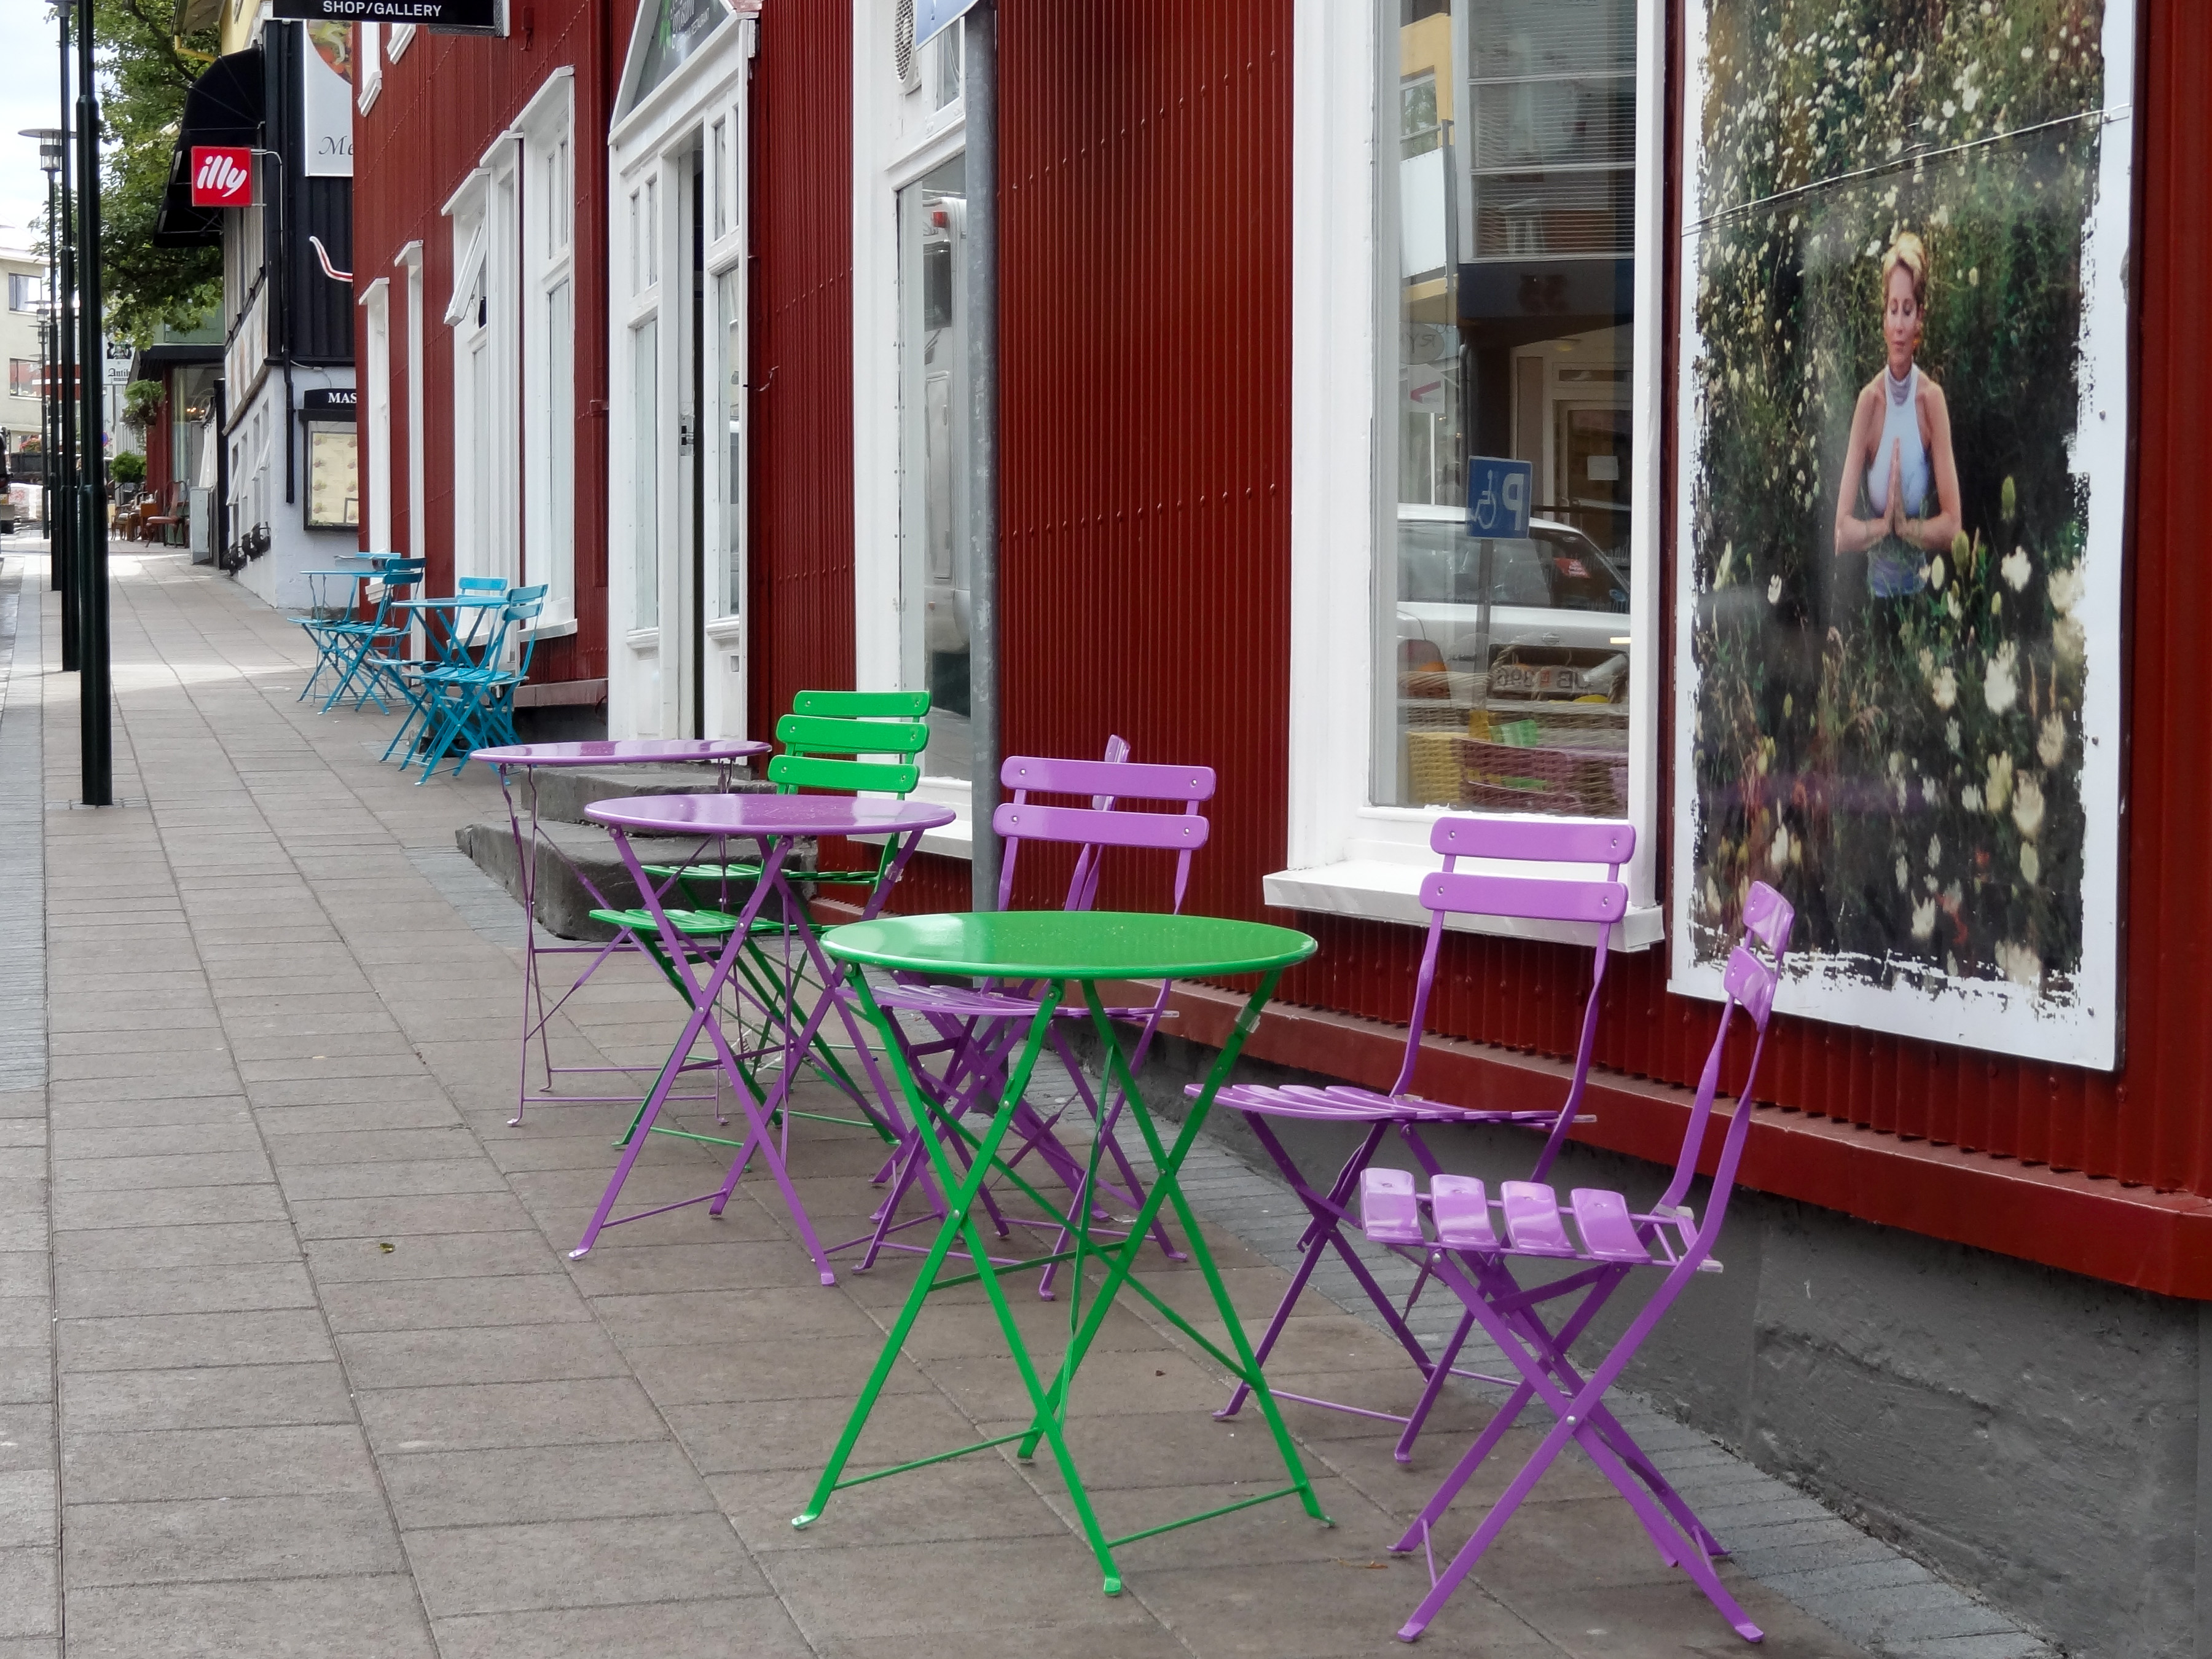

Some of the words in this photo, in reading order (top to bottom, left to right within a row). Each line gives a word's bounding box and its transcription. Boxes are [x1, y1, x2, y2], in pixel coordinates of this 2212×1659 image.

[323, 1, 442, 17] SHOP/GALLERY
[197, 155, 247, 197] illy
[328, 392, 356, 403] MAS
